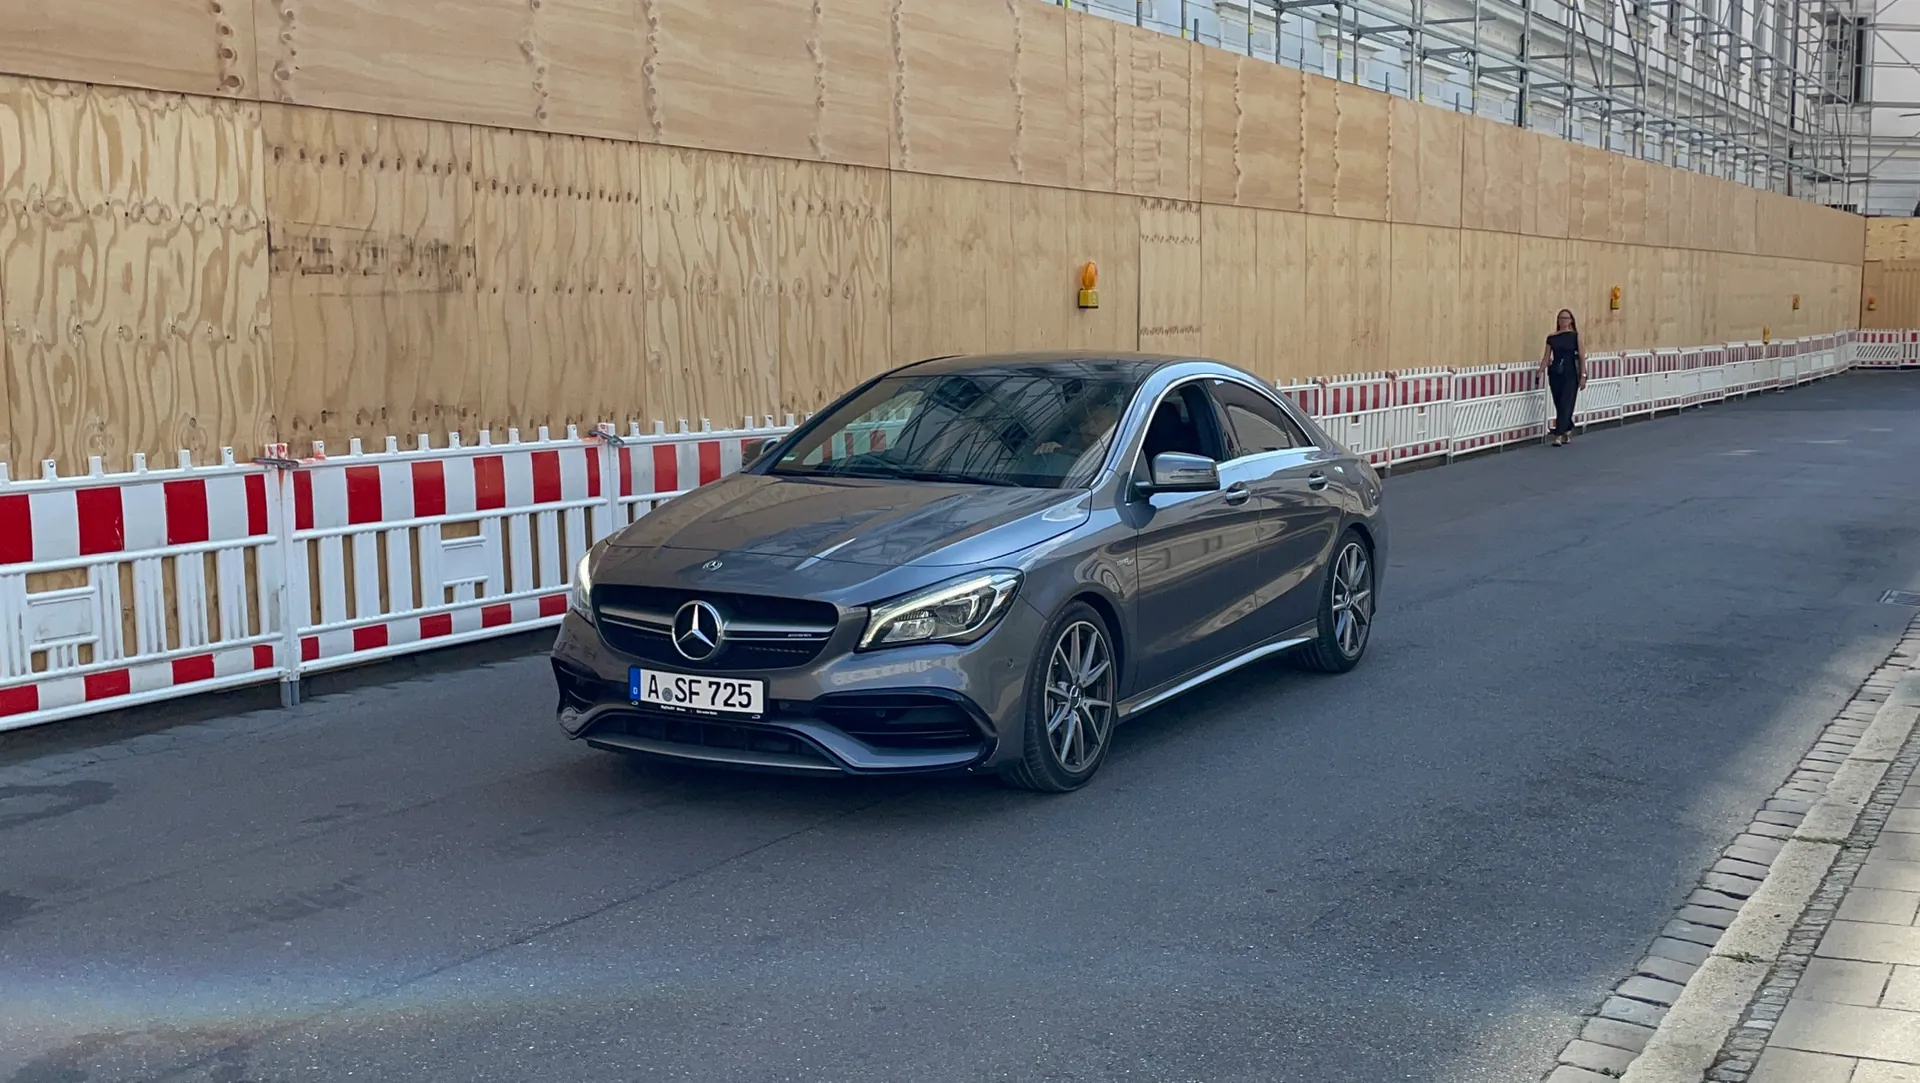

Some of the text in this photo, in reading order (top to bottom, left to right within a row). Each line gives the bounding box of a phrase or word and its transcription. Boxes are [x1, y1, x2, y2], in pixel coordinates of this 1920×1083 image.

[648, 675, 752, 708] A SF 725
